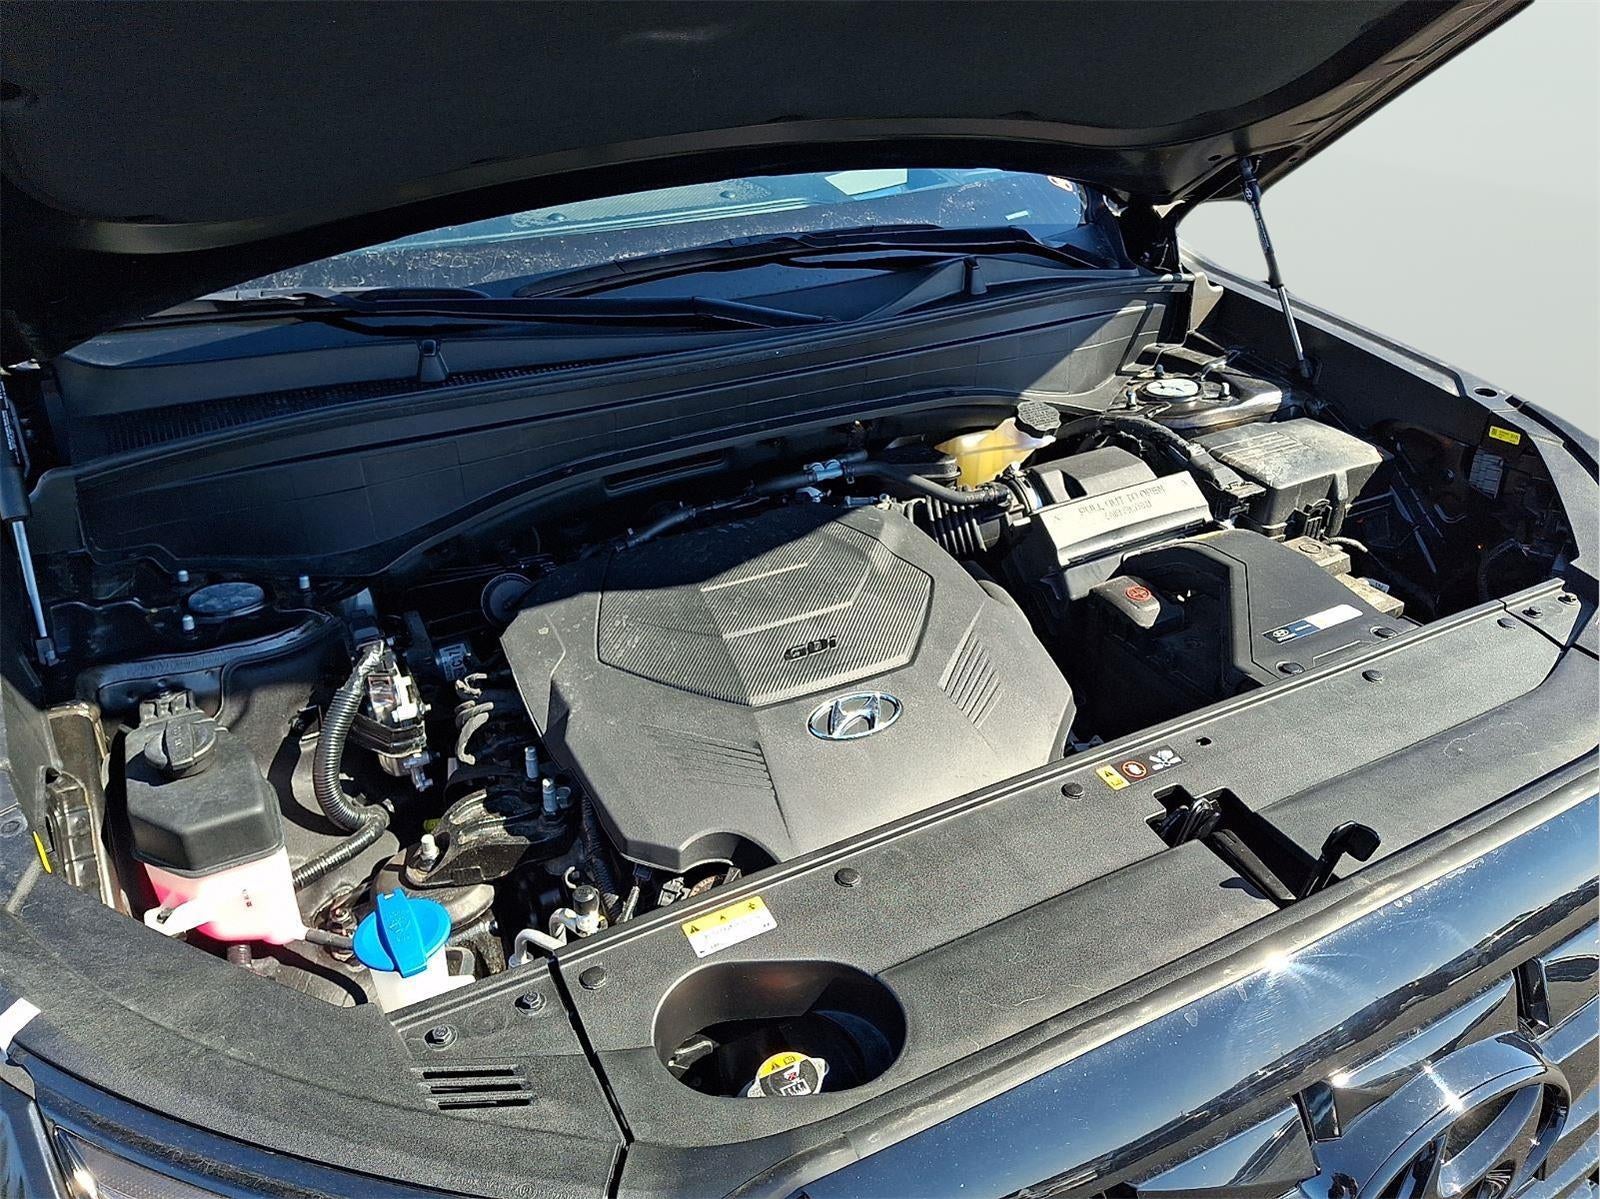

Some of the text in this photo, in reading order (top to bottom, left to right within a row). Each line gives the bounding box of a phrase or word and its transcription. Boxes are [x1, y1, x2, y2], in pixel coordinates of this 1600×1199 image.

[1078, 502, 1105, 515] PULL
[1104, 495, 1124, 508] OUT
[1126, 492, 1139, 502] TO
[1139, 484, 1166, 497] OPEN
